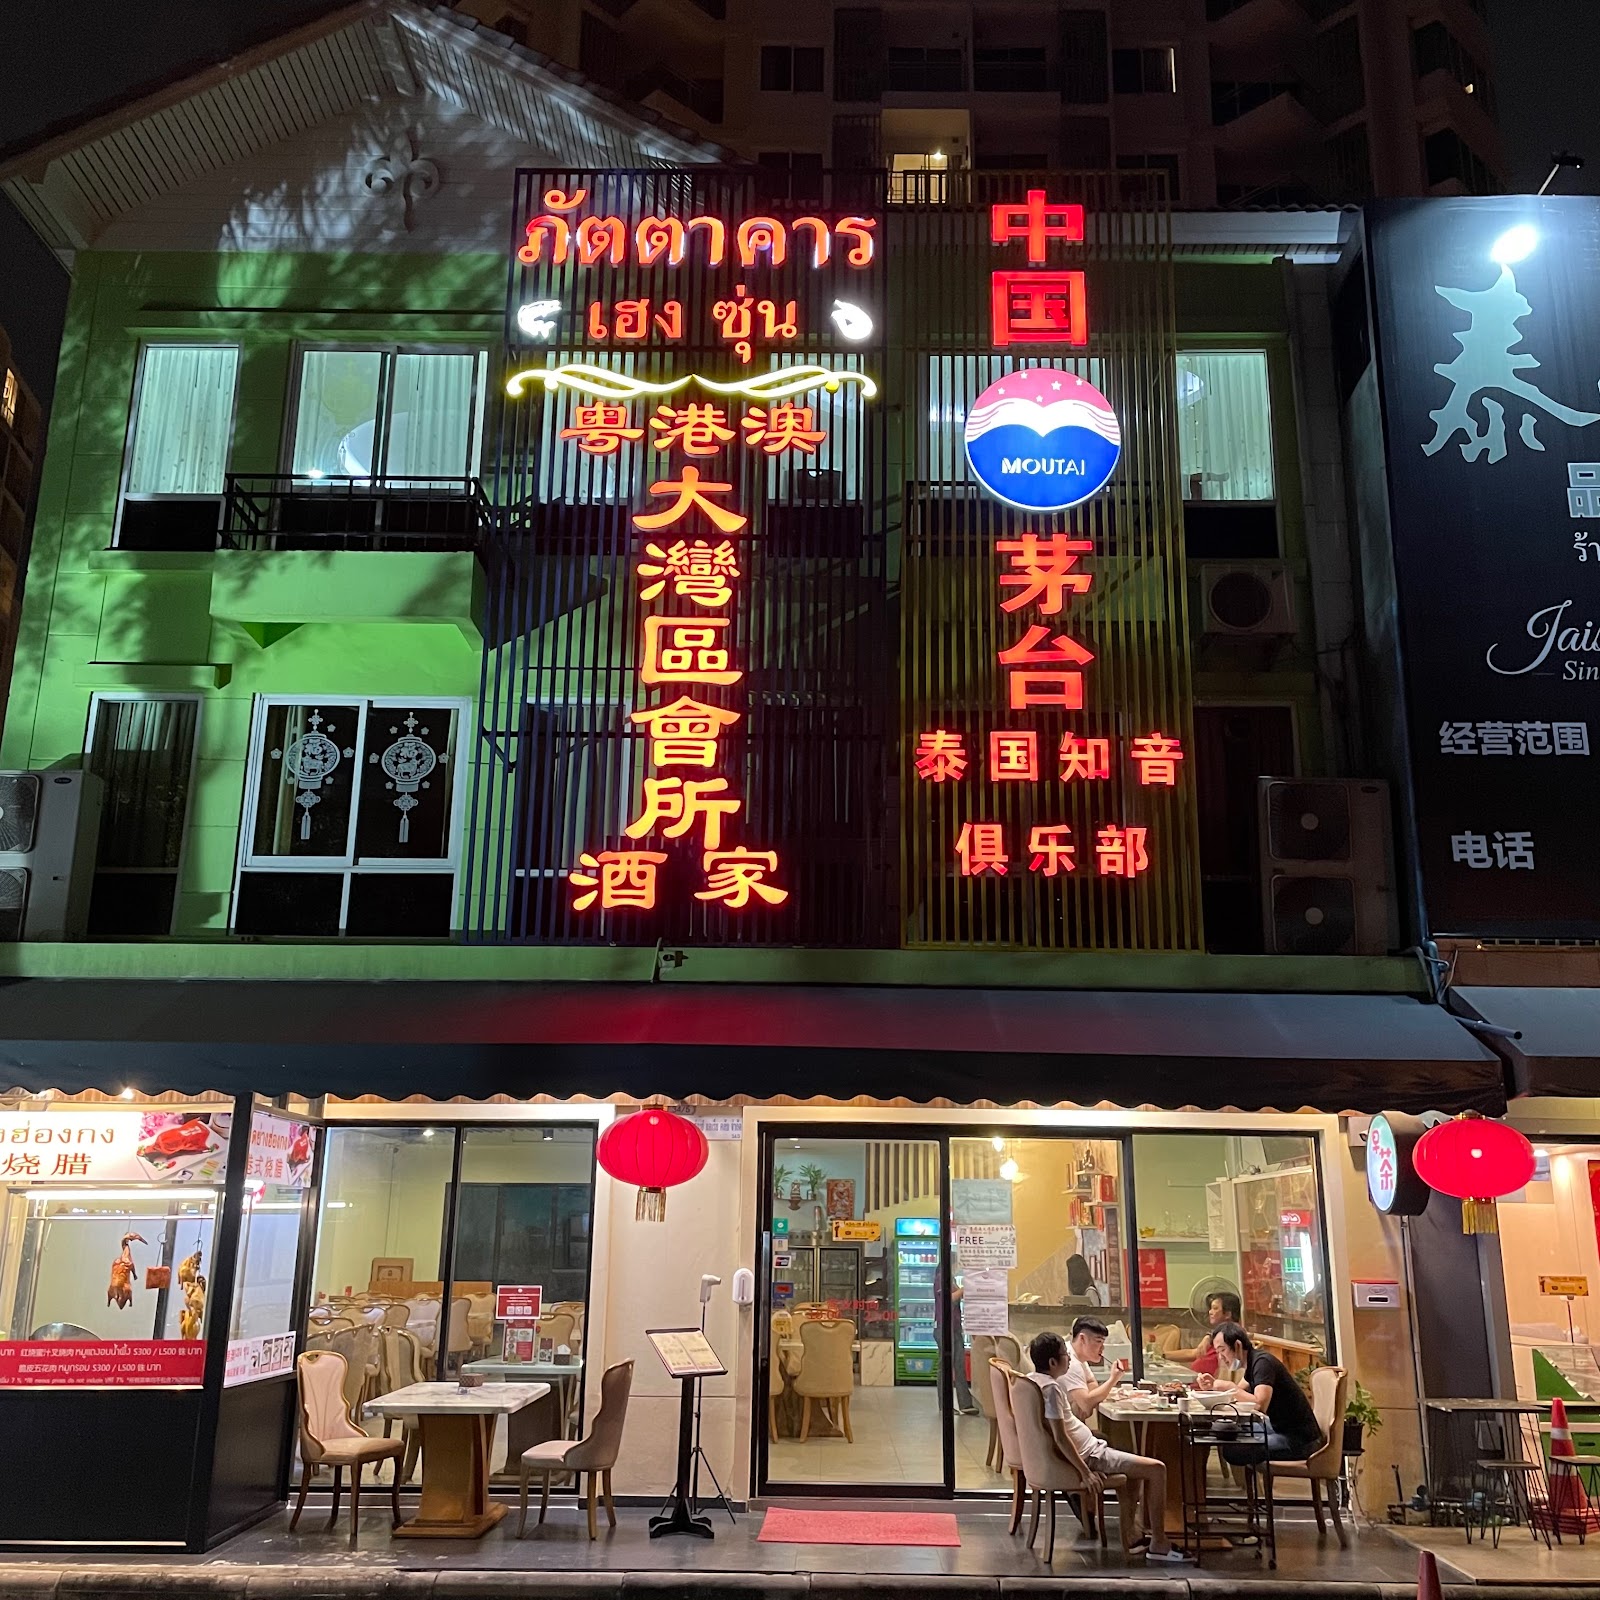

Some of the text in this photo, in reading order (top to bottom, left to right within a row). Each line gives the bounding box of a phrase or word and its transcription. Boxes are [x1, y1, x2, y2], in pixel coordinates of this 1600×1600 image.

[518, 189, 877, 266] ภัตตาคาร
[992, 190, 1087, 346] 中国
[588, 286, 797, 363] เฮง ซุ่น
[1002, 458, 1086, 476] MOUTAI
[996, 533, 1095, 709] 茅台
[624, 466, 747, 850] 大灣區會所
[915, 729, 1184, 786] 泰国知音
[1439, 721, 1590, 756] 经营范围
[568, 846, 789, 910] 酒家
[955, 822, 1149, 878] 俱乐部
[1451, 830, 1534, 870] 电话
[959, 1236, 984, 1245] FREE
[92, 1363, 110, 1372] S300
[118, 1363, 136, 1372] L500
[133, 1347, 151, 1356] S300
[159, 1347, 176, 1355] L500
